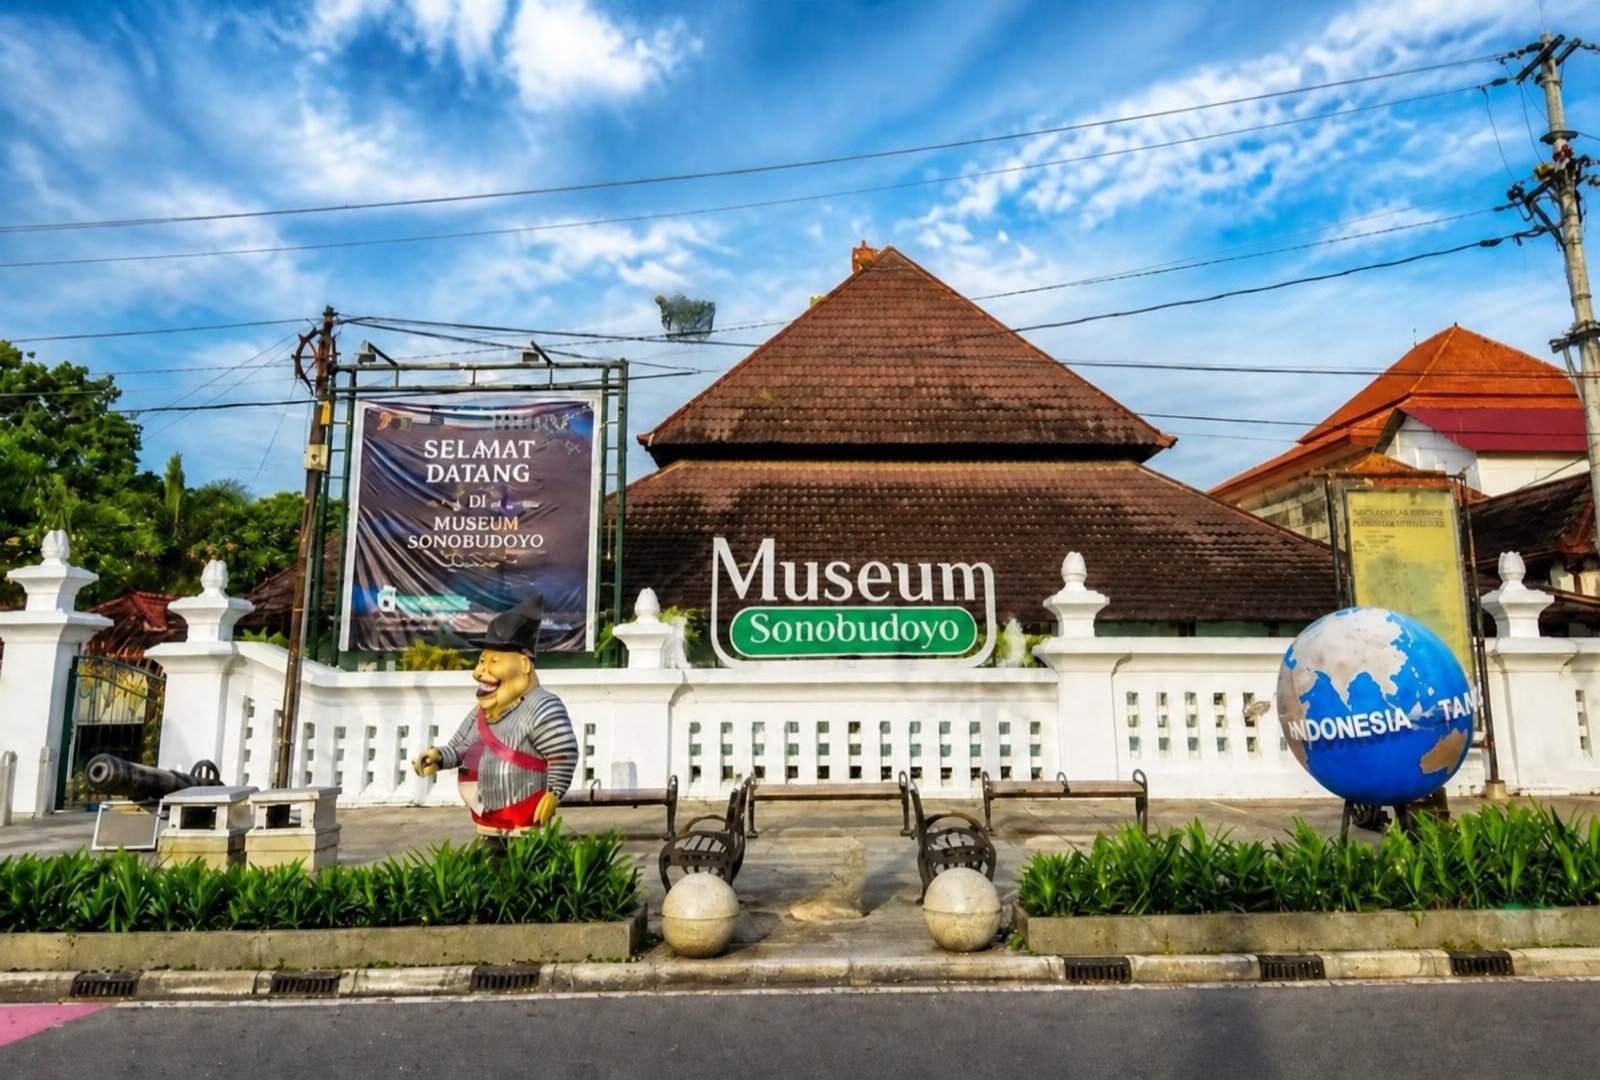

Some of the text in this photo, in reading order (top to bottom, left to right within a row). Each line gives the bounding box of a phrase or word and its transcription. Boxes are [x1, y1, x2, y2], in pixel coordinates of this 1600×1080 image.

[424, 439, 535, 459] SELAMAT
[426, 463, 530, 483] DATANG
[469, 495, 486, 508] DI
[433, 516, 519, 531] MUSEUM
[407, 534, 544, 549] SONOBUDOYO
[711, 537, 995, 602] Museum
[750, 613, 959, 649] Sonobudoyo
[1288, 707, 1412, 742] INDONESIA
